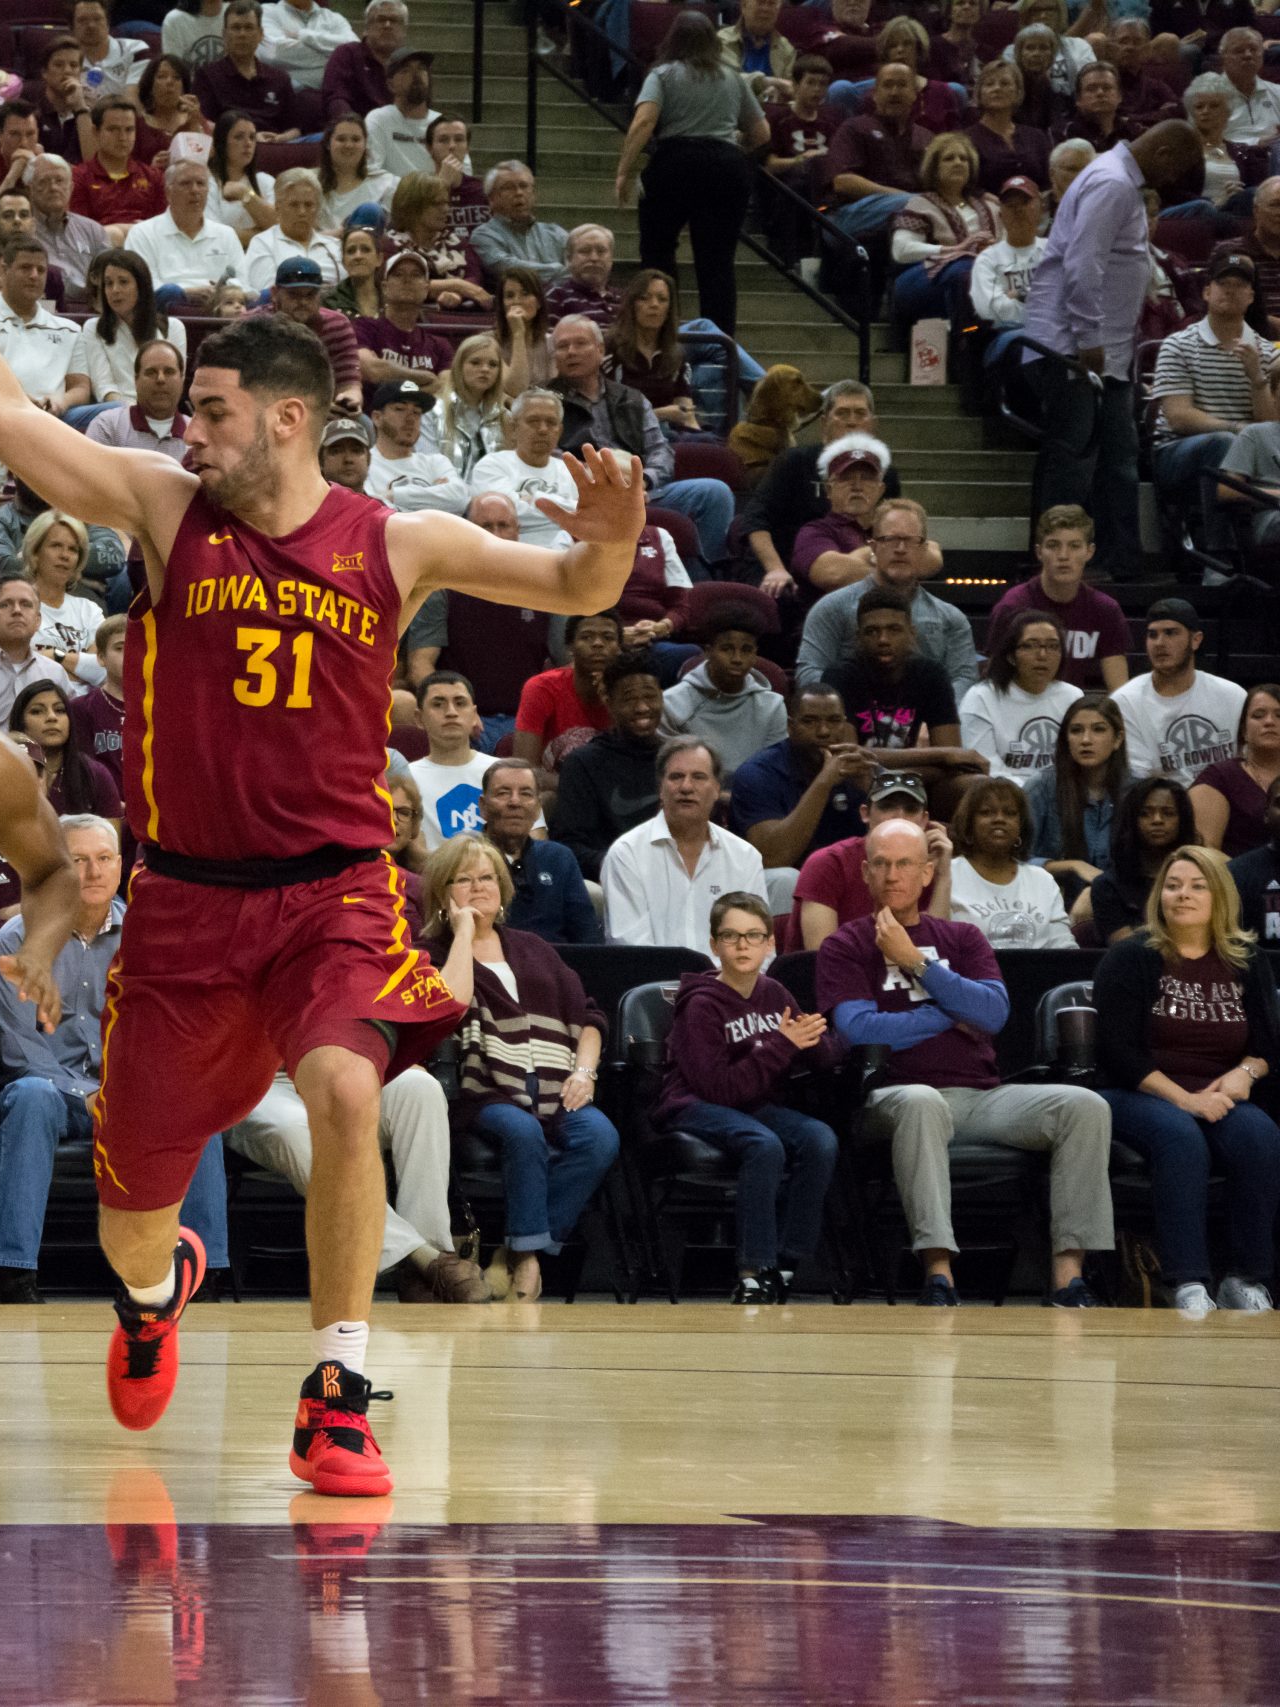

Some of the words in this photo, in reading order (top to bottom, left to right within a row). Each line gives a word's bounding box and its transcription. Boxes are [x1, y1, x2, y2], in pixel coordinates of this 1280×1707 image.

[185, 574, 269, 619] IOWA
[277, 579, 381, 647] STATE
[232, 626, 315, 709] 31
[94, 731, 123, 755] AG
[968, 895, 1045, 924] Believe
[1151, 995, 1248, 1023] AGGIES
